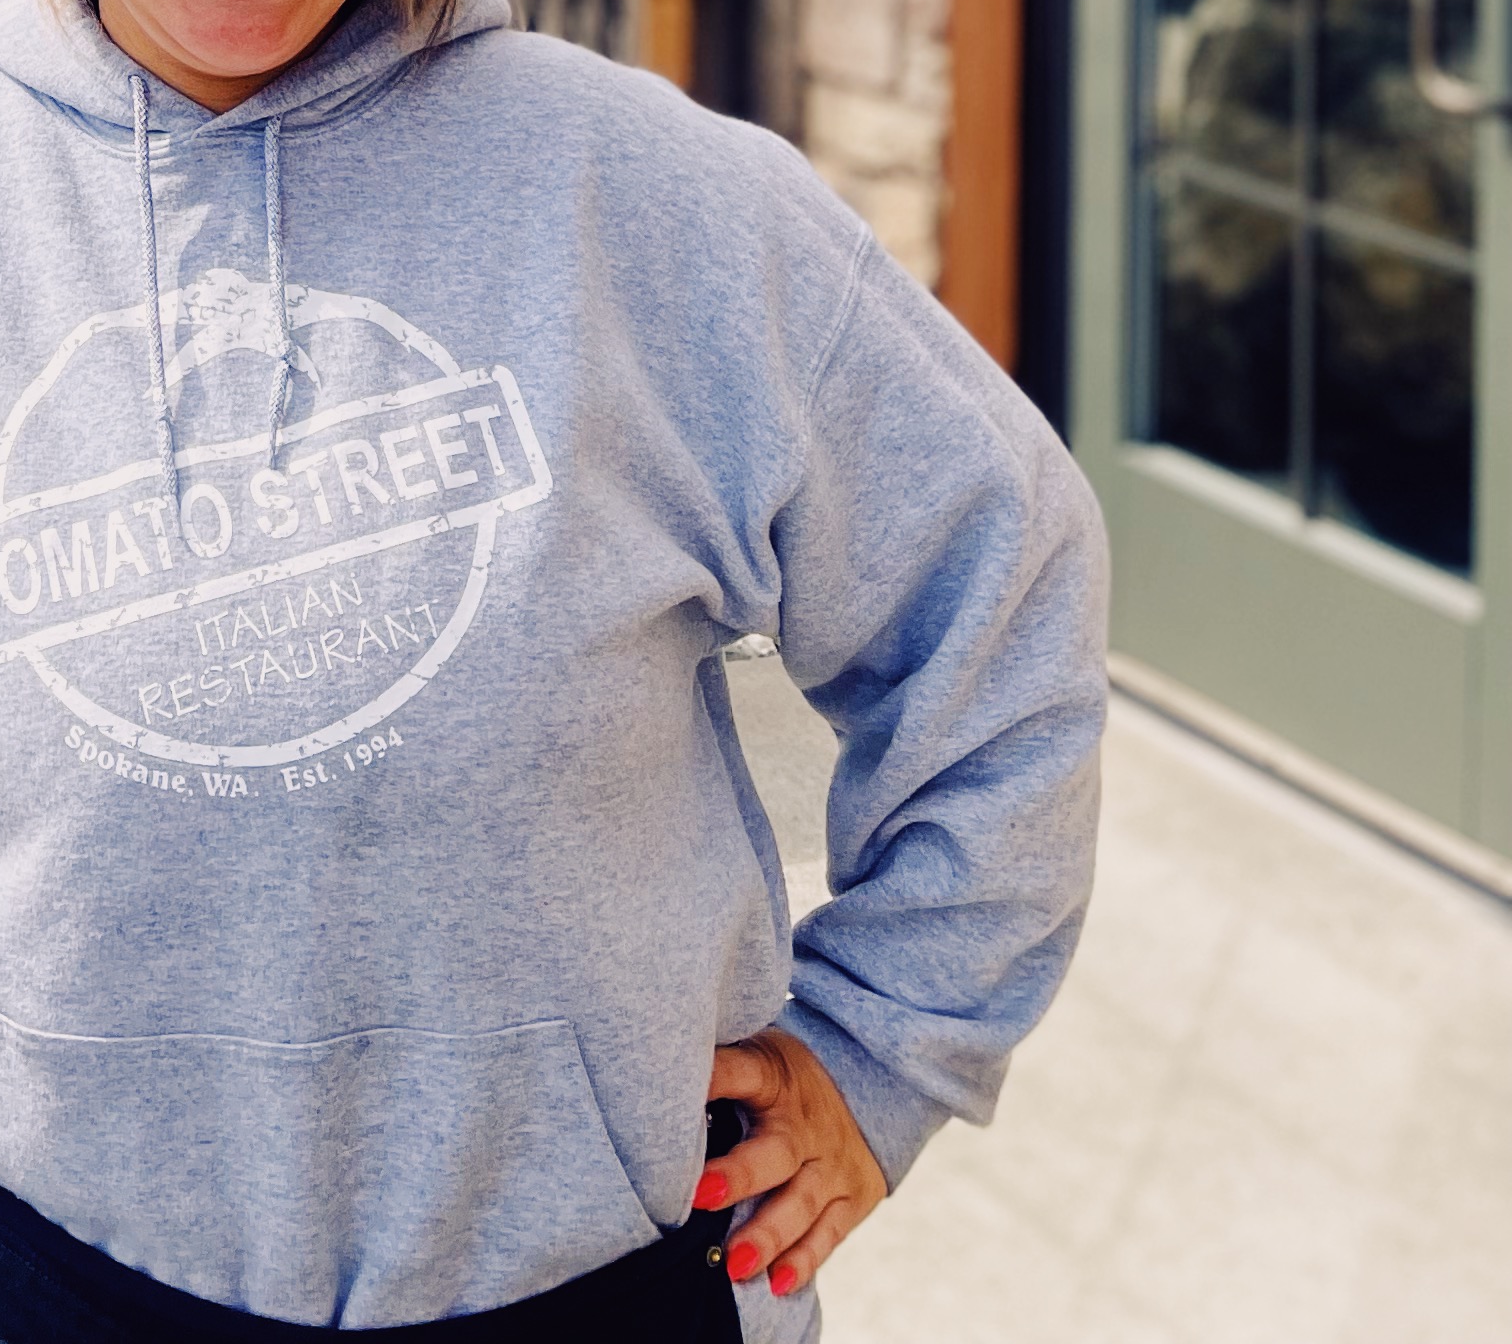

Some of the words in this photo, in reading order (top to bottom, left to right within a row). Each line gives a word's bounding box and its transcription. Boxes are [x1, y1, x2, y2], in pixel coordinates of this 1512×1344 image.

[249, 404, 507, 540] STREET
[138, 598, 439, 725] RESTAURANT
[195, 571, 362, 655] ITALIAN
[63, 725, 194, 797] Spokane,
[281, 761, 337, 792] Est.
[343, 726, 404, 772] 1994
